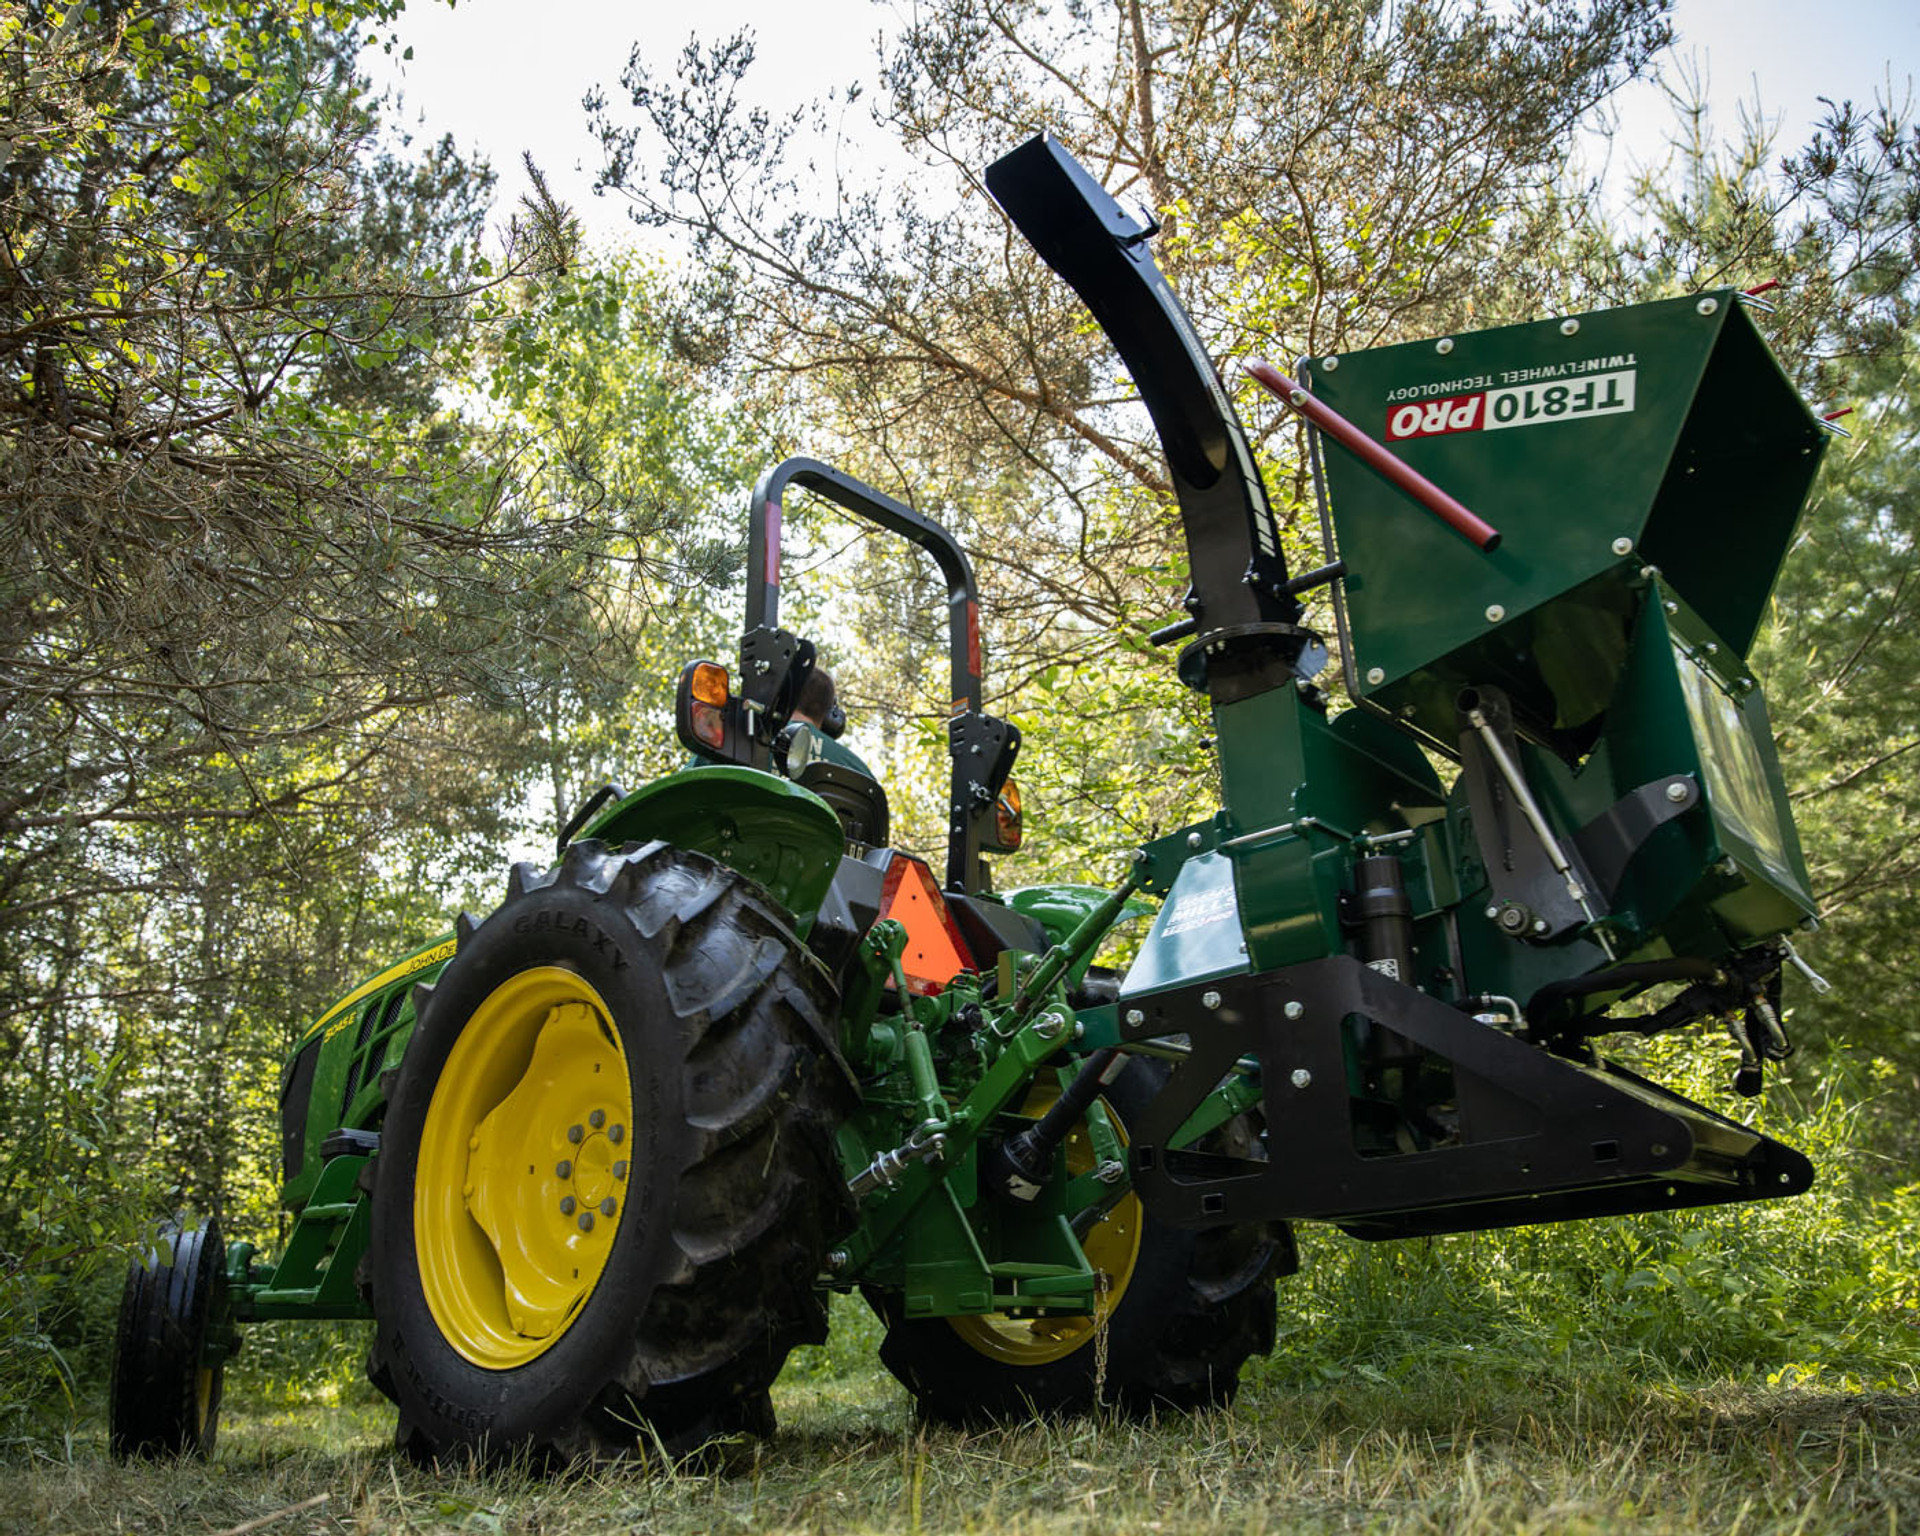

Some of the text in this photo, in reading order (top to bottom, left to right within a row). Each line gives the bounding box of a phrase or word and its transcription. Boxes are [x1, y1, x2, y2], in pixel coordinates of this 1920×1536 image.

[1387, 353, 1637, 401] TWINFLYWHEEL TECHNOLOGY
[1391, 378, 1625, 437] TF810 PRO
[406, 949, 439, 973] JOHN
[513, 908, 632, 970] GALAXY
